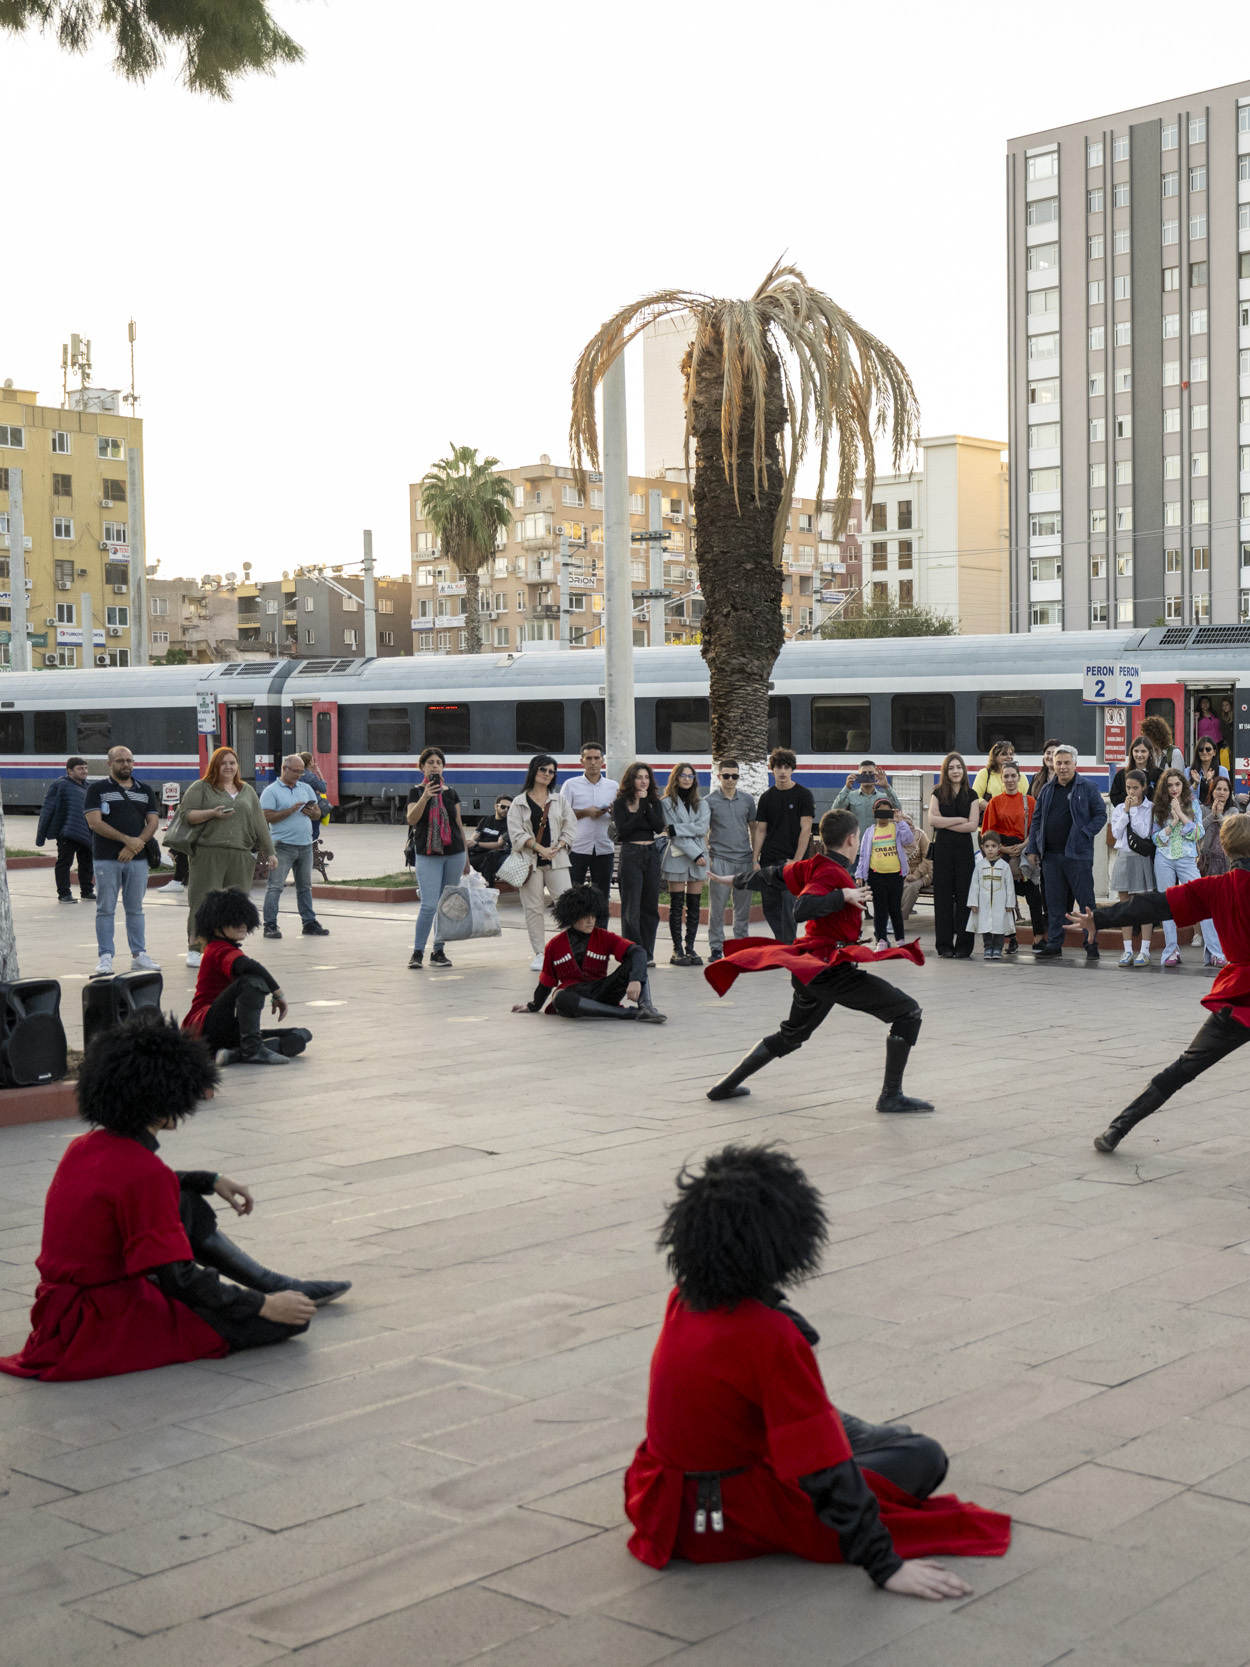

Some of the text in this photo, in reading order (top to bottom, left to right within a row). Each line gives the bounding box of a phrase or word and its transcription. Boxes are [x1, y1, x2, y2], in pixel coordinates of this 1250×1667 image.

[1086, 666, 1114, 676] PERON
[1119, 666, 1139, 677] PERON
[1094, 679, 1105, 697] 2
[1125, 680, 1133, 698] 2
[1243, 758, 1250, 768] 3
